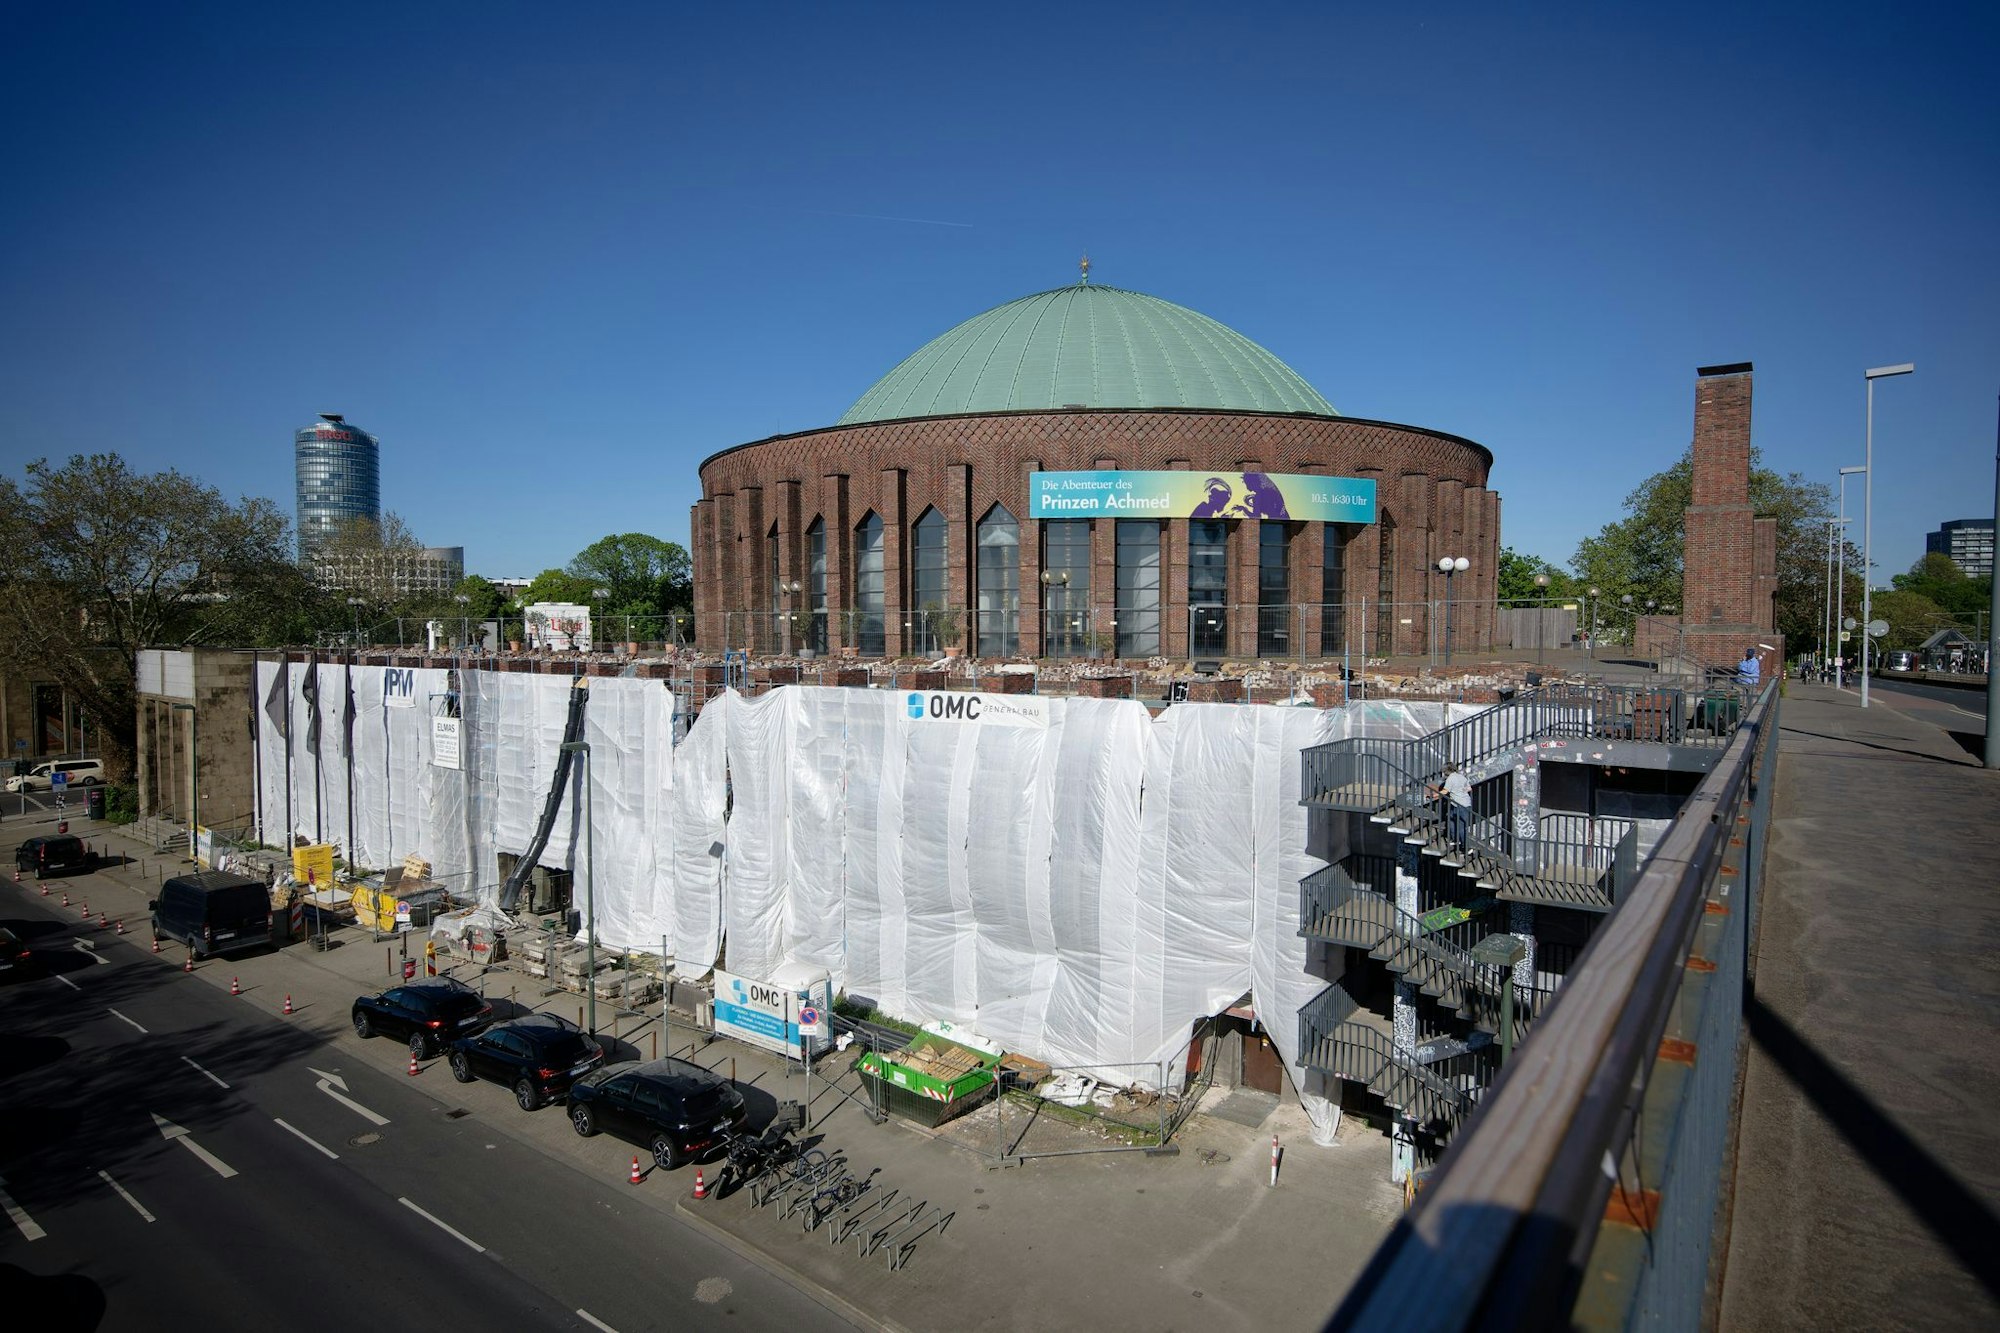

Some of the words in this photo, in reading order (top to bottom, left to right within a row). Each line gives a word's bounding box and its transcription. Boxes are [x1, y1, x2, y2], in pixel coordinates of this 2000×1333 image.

[1042, 480, 1059, 490] Die
[1062, 480, 1112, 490] Abenteuer
[1115, 480, 1133, 490] des
[1042, 494, 1099, 510] Prinzen
[1105, 492, 1170, 509] Achmed
[1311, 493, 1329, 504] 10.5.
[1351, 495, 1367, 506] Uhr
[930, 695, 982, 720] OMC
[983, 704, 1040, 717] GENERALBAU
[437, 722, 456, 733] ELMAS
[750, 985, 779, 1007] OMC
